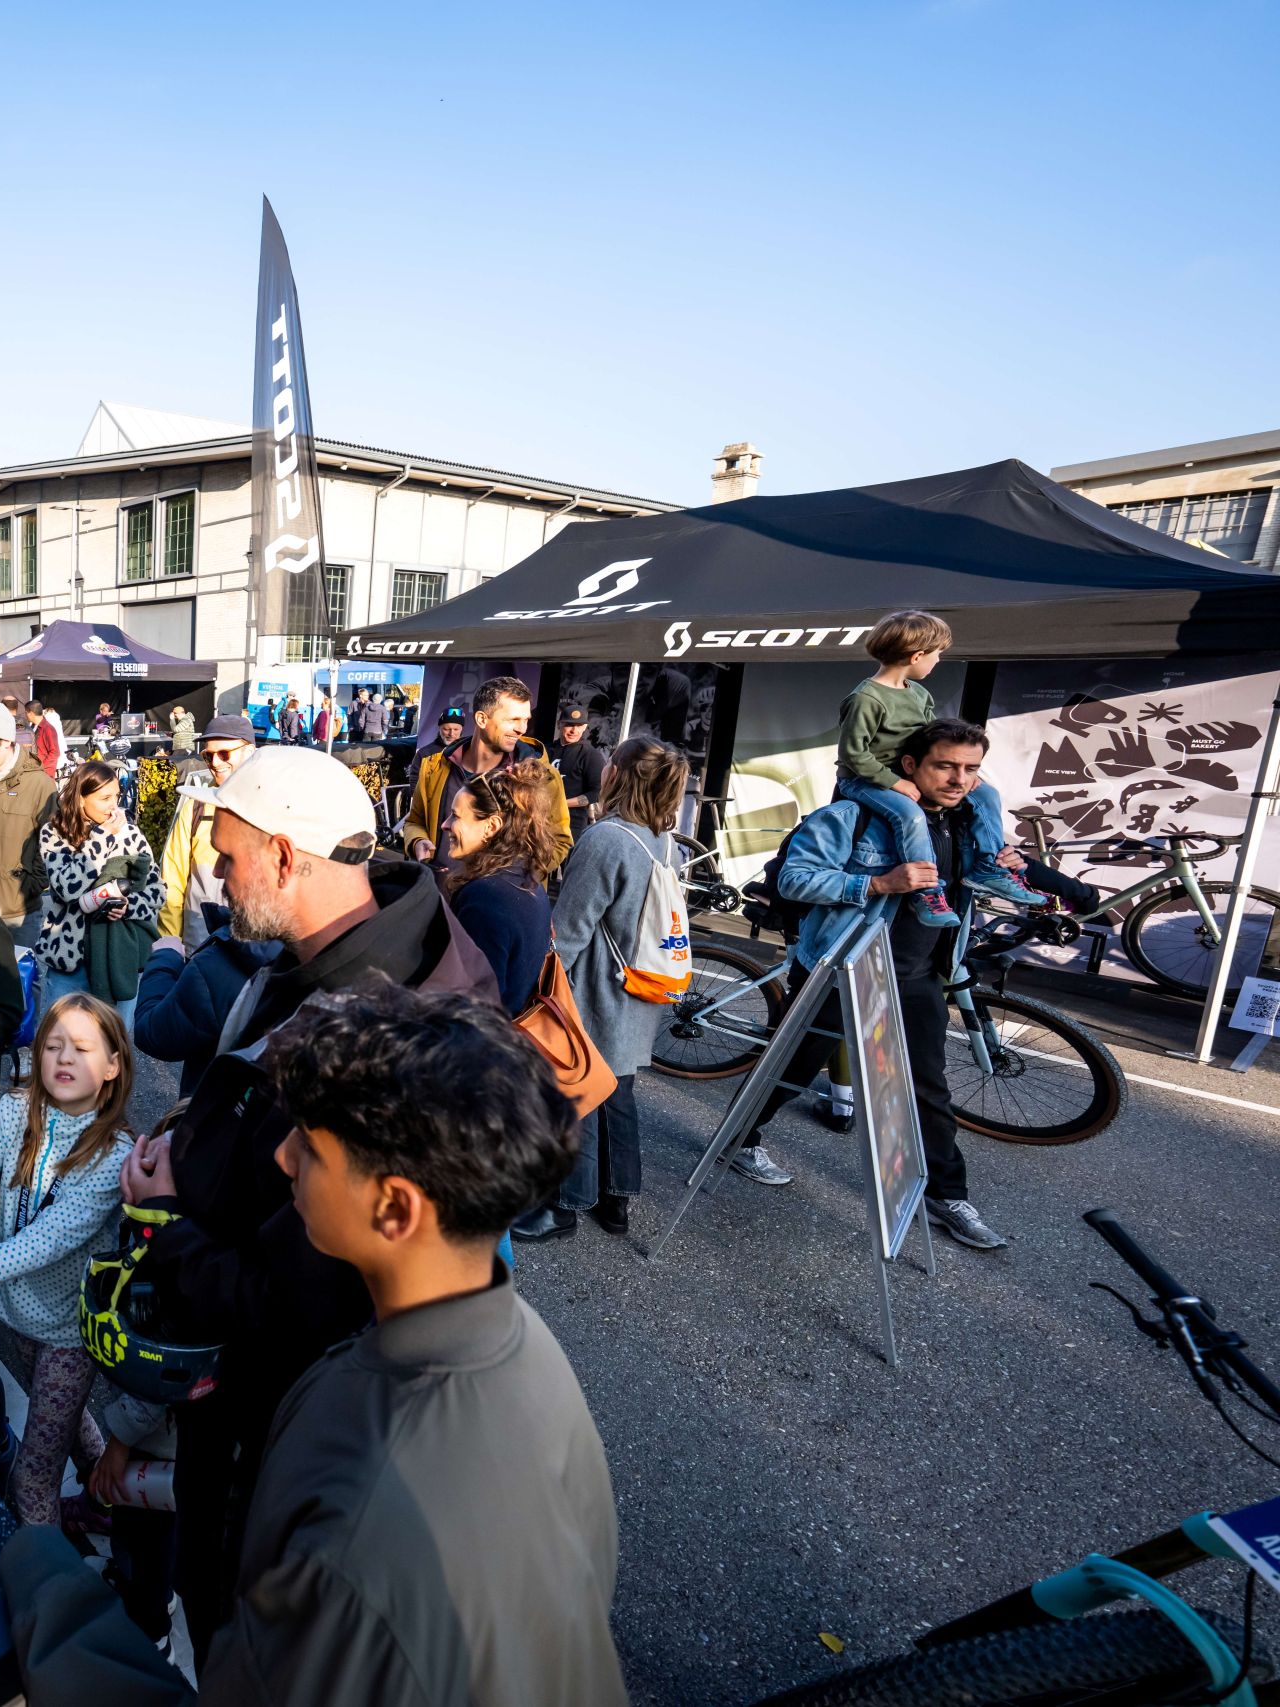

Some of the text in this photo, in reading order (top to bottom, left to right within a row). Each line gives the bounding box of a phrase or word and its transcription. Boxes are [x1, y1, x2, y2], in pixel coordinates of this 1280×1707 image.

[482, 600, 673, 621] SCOTT
[695, 625, 875, 649] SCOTT
[363, 639, 455, 656] SCOTT
[112, 662, 148, 672] FELSENAU
[347, 671, 387, 681] COFFEE
[138, 1349, 163, 1362] uvex
